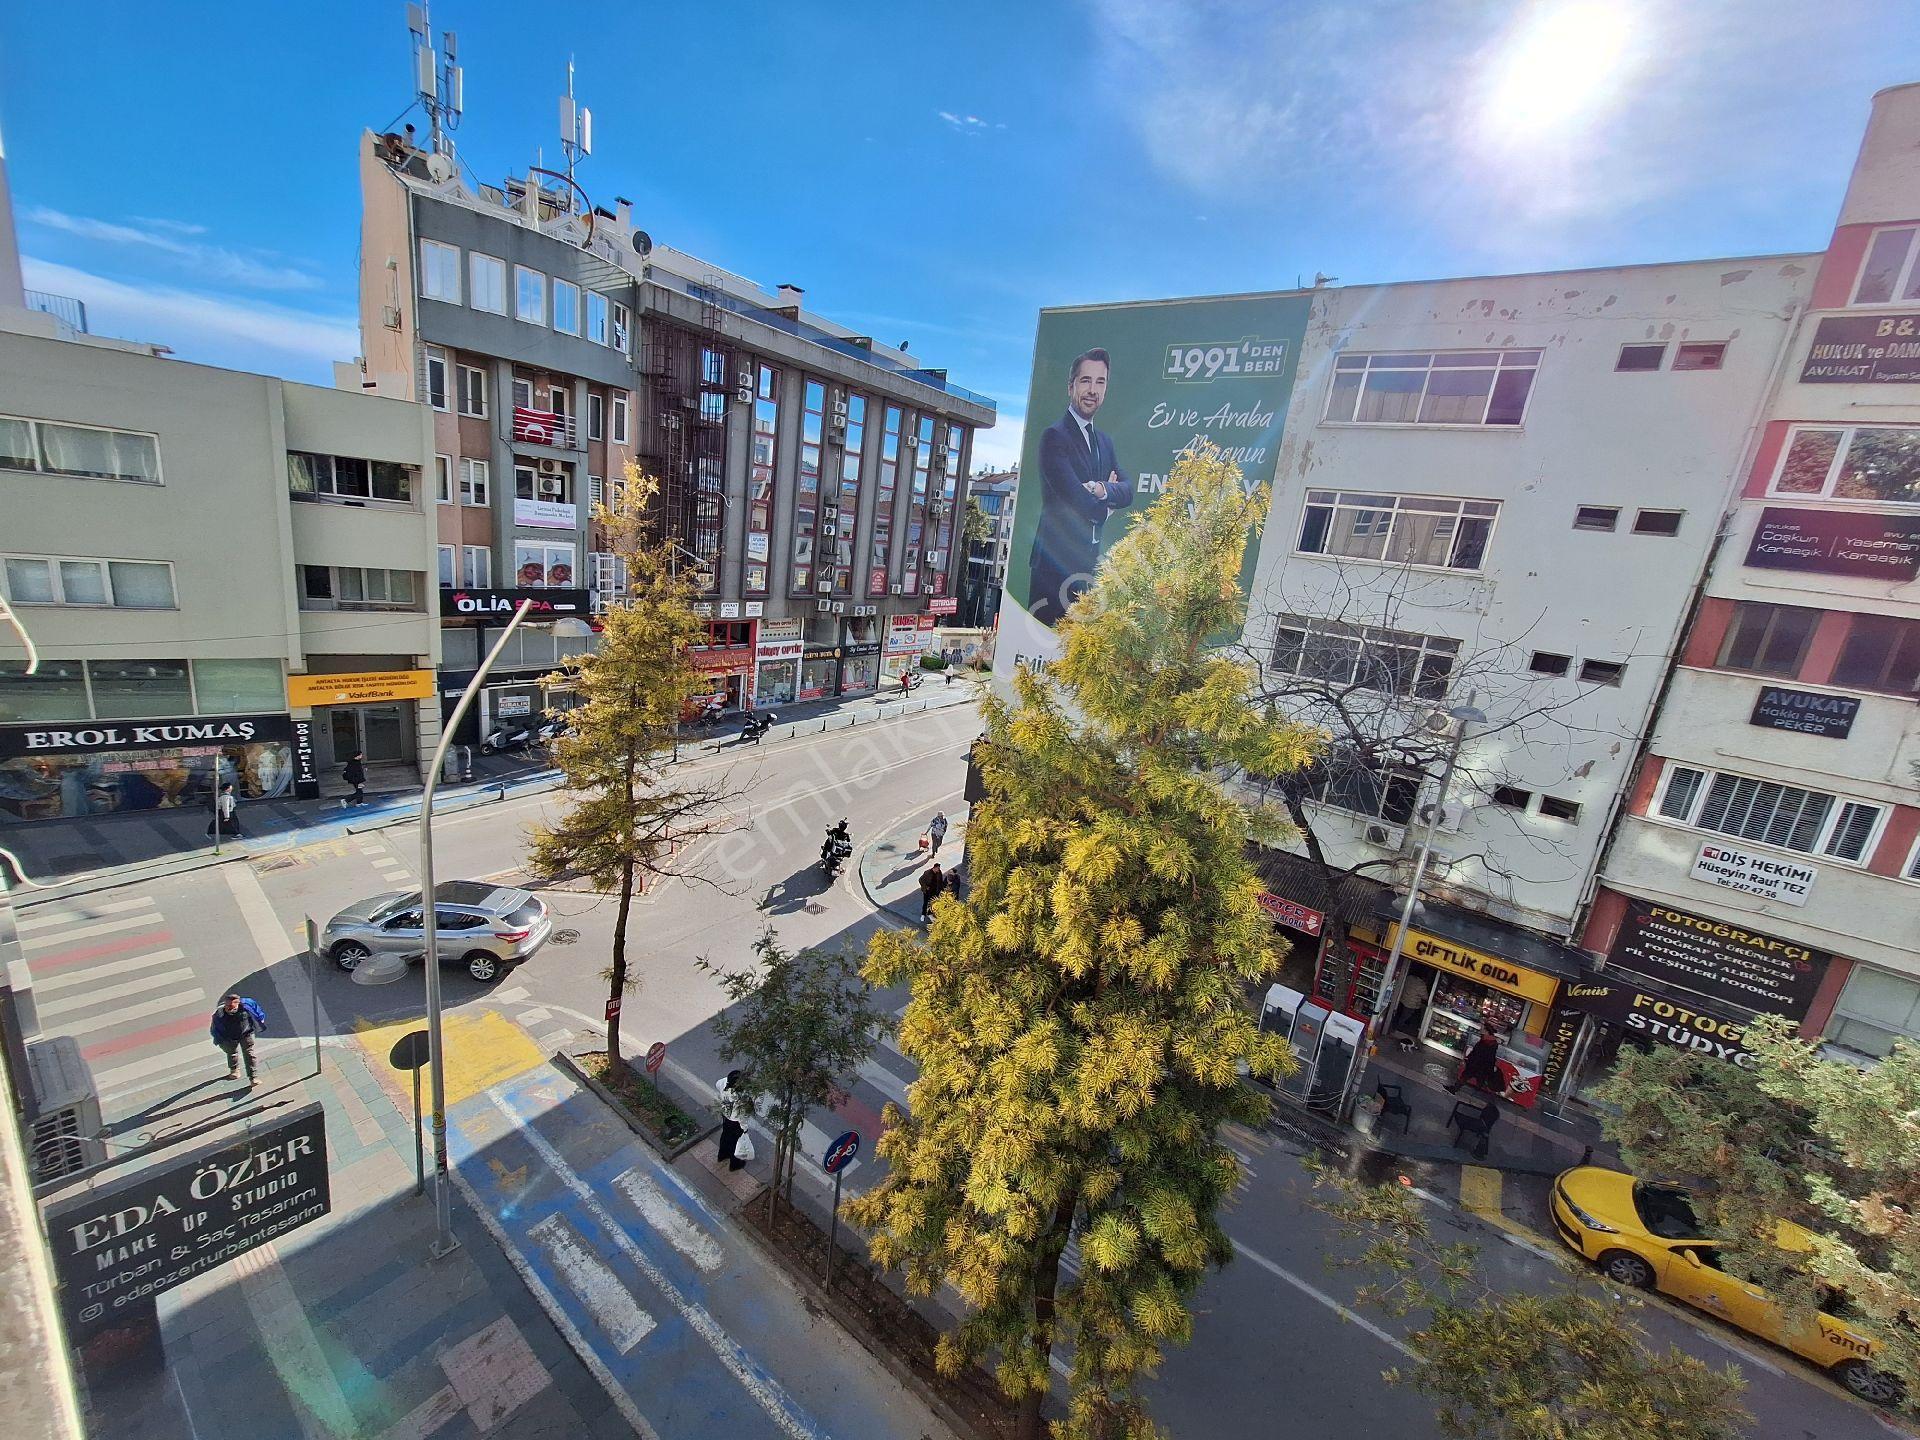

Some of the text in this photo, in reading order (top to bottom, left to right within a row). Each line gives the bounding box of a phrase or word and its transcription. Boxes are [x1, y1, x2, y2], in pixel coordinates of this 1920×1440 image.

[1812, 342, 1920, 359] HUKUK ve DAN
[1244, 358, 1280, 372] BERİ
[1805, 365, 1870, 377] AVUKAT
[1148, 400, 1274, 429] Ev ve Araba
[1757, 544, 1822, 558] Karaaşık
[1761, 531, 1818, 544] Coşkun
[1845, 537, 1919, 551] Yasemen
[1837, 550, 1914, 565] Karaaşık
[1759, 706, 1849, 727] Hakkı Burak
[1763, 692, 1855, 714] AVUKAT
[25, 722, 255, 748] EROL KUMAŞ
[1774, 719, 1825, 733] PEKER
[1698, 861, 1806, 895] Hüseyin Rauf TEZ
[1720, 851, 1813, 882] DİŞ HEKİMİ
[1732, 882, 1750, 890] 247
[1752, 887, 1763, 895] 47
[1764, 890, 1777, 899] 56
[1650, 907, 1812, 961] FOTOĞRAFÇI
[1650, 922, 1791, 969] HEDİYELİK ÜRÜNLER
[1416, 940, 1519, 987] ÇİFTLİK GIDA
[1638, 929, 1796, 982] FOTOĞRAF ÇERÇEVESİ
[1644, 942, 1780, 988] FOTOĞRAF ALBÜMÜ
[1625, 947, 1793, 1005] PİL ÇEŞİTLERİ FOTOKOPİ
[1567, 983, 1618, 998] Venüs
[1632, 993, 1752, 1049] FOTOĞ
[66, 1135, 314, 1255] EDA ÖZER
[170, 1245, 191, 1260] &
[196, 1224, 236, 1250] Saç
[238, 1187, 317, 1228] Tasarımı
[96, 1233, 158, 1271] MAKE
[182, 1211, 208, 1233] UP
